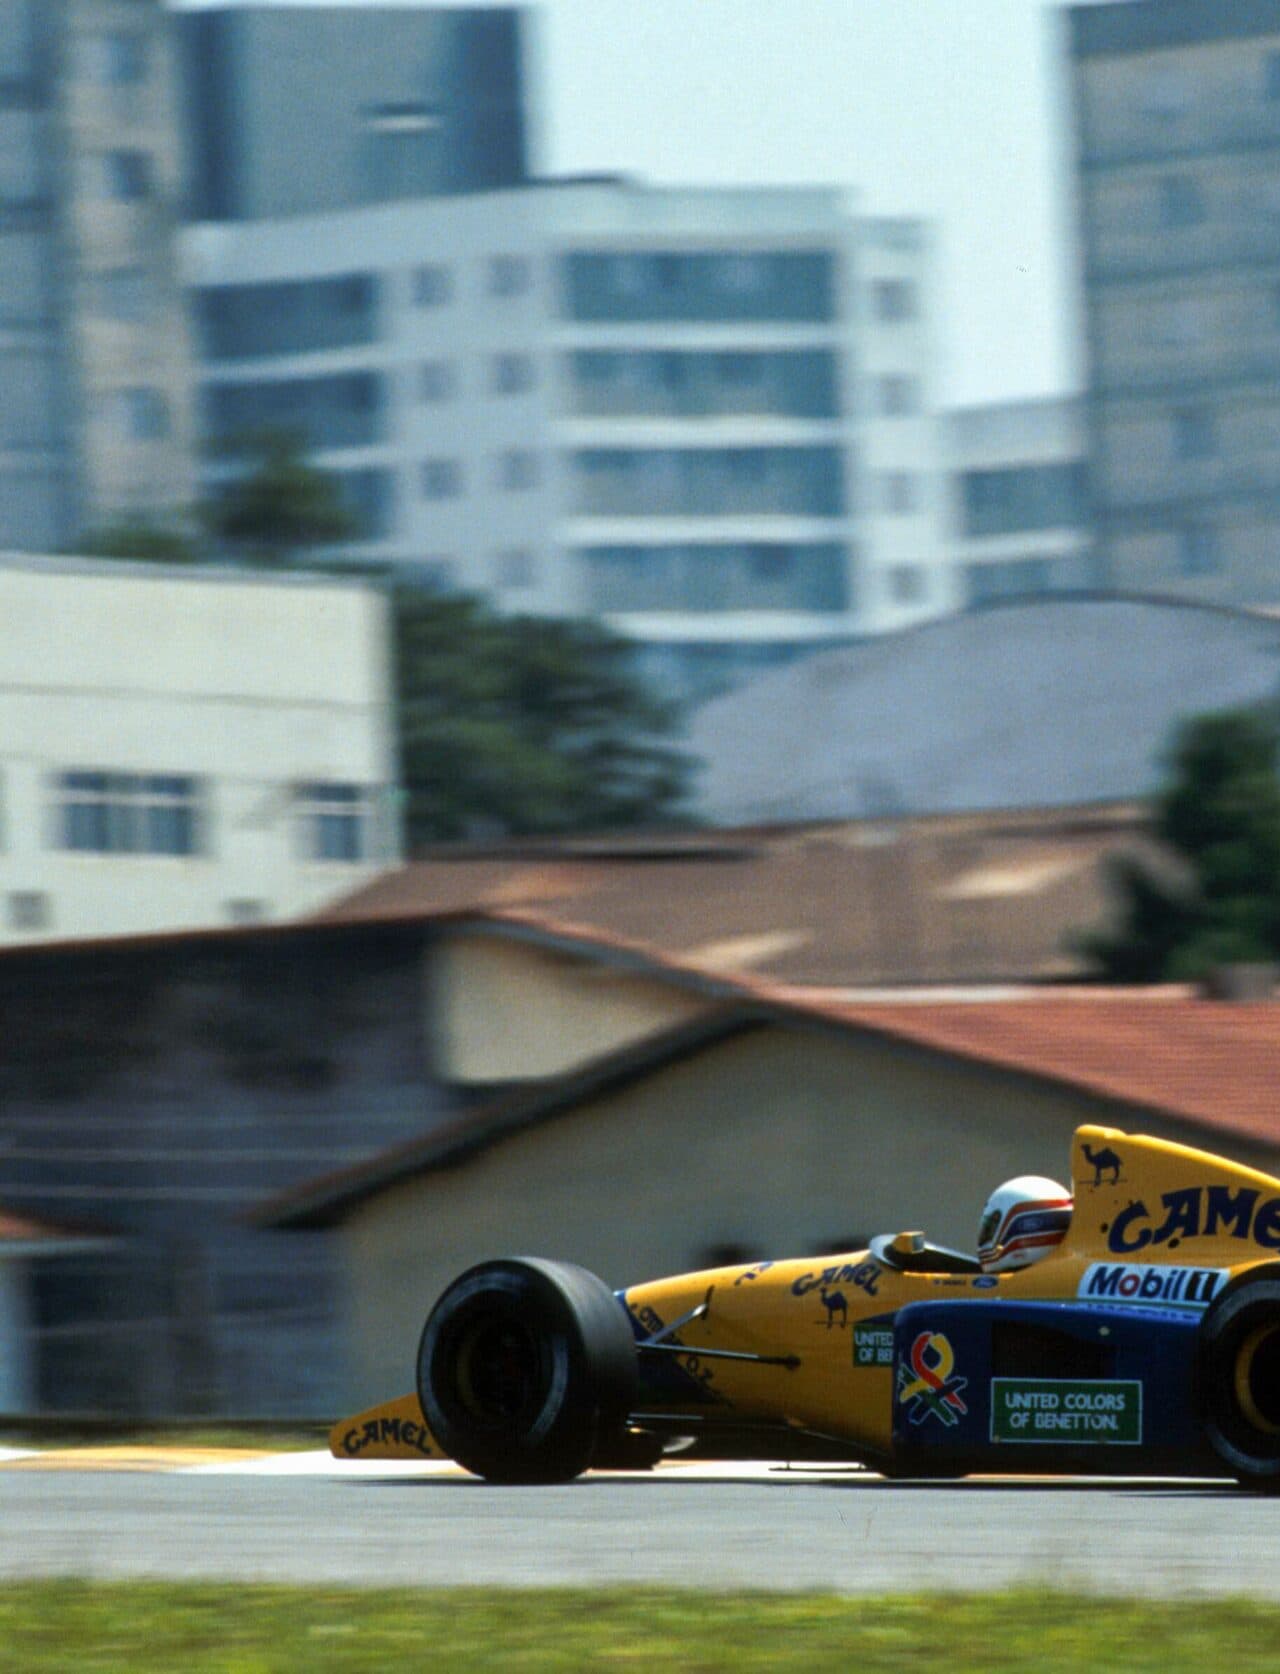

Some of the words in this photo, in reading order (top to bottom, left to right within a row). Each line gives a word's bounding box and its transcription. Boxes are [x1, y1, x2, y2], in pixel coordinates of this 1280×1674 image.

[791, 1262, 882, 1296] CAMEL
[1088, 1266, 1186, 1299] Mobil
[860, 1348, 874, 1362] OF
[1005, 1392, 1059, 1409] UNITED
[1064, 1393, 1126, 1410] COLORS
[1010, 1411, 1030, 1428] OF
[342, 1417, 432, 1455] CAMEL
